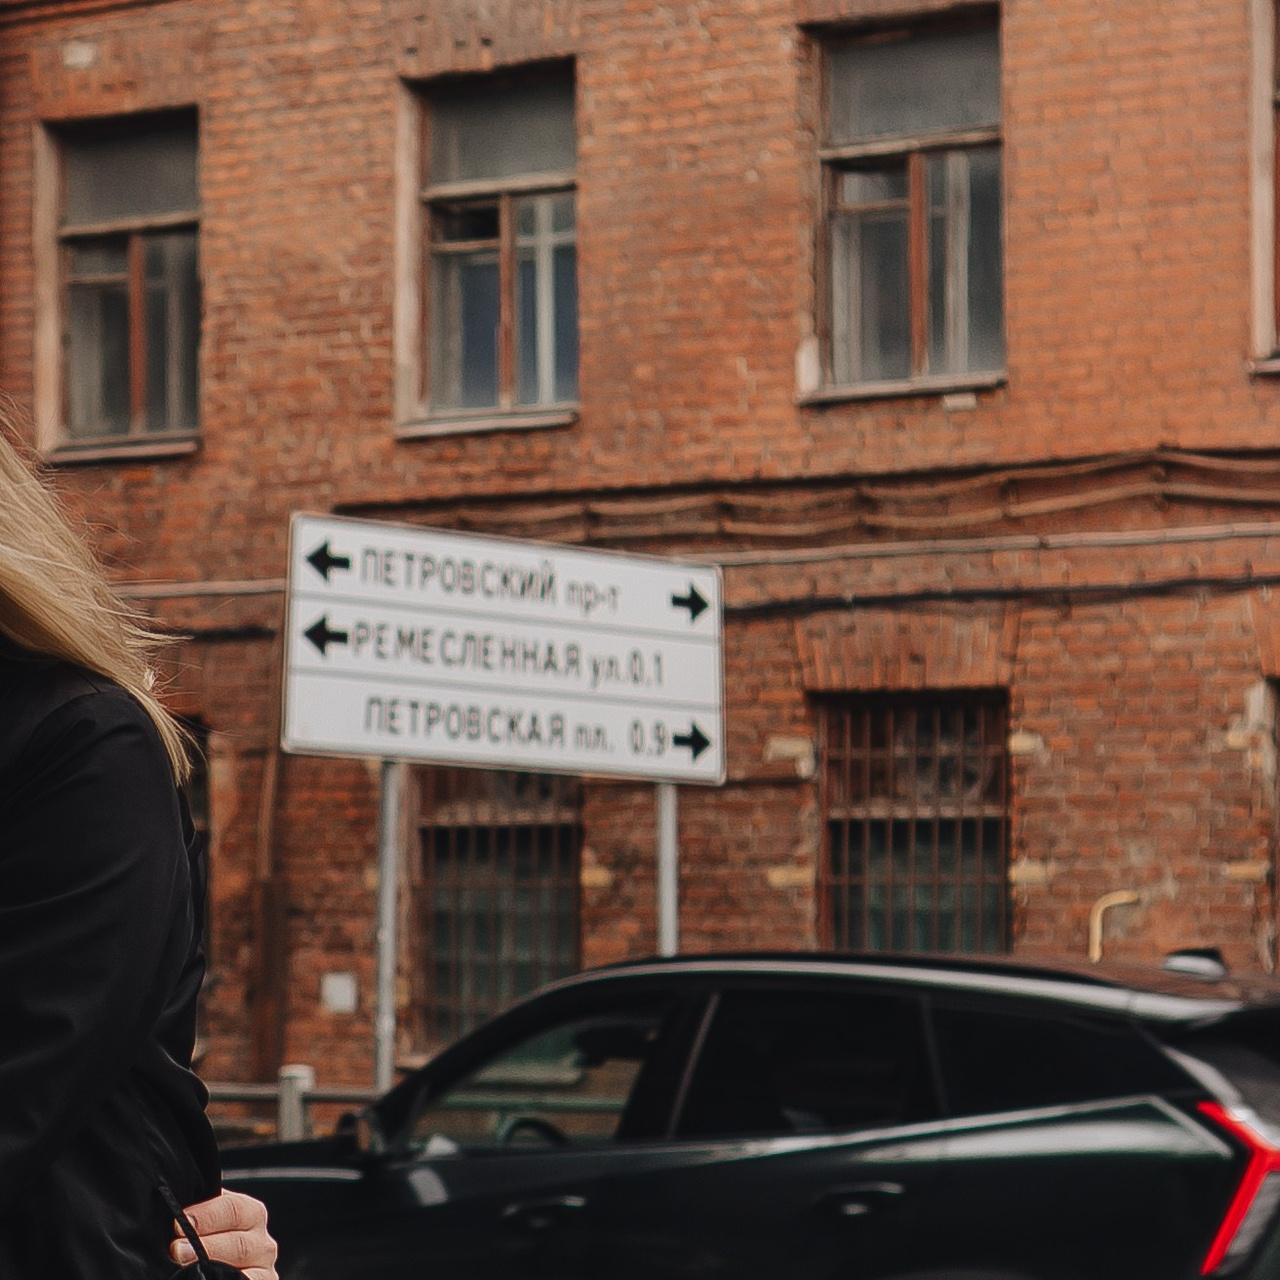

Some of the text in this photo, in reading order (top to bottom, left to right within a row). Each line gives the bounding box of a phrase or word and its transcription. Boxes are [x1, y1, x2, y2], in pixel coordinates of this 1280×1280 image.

[361, 548, 620, 618] ПЕТРОВСКИЙ пр-т
[352, 621, 580, 677] РЕМЕСЛЕННАЯ
[365, 696, 564, 749] ПЕТРОВСКАЯ
[575, 722, 616, 754] пл.
